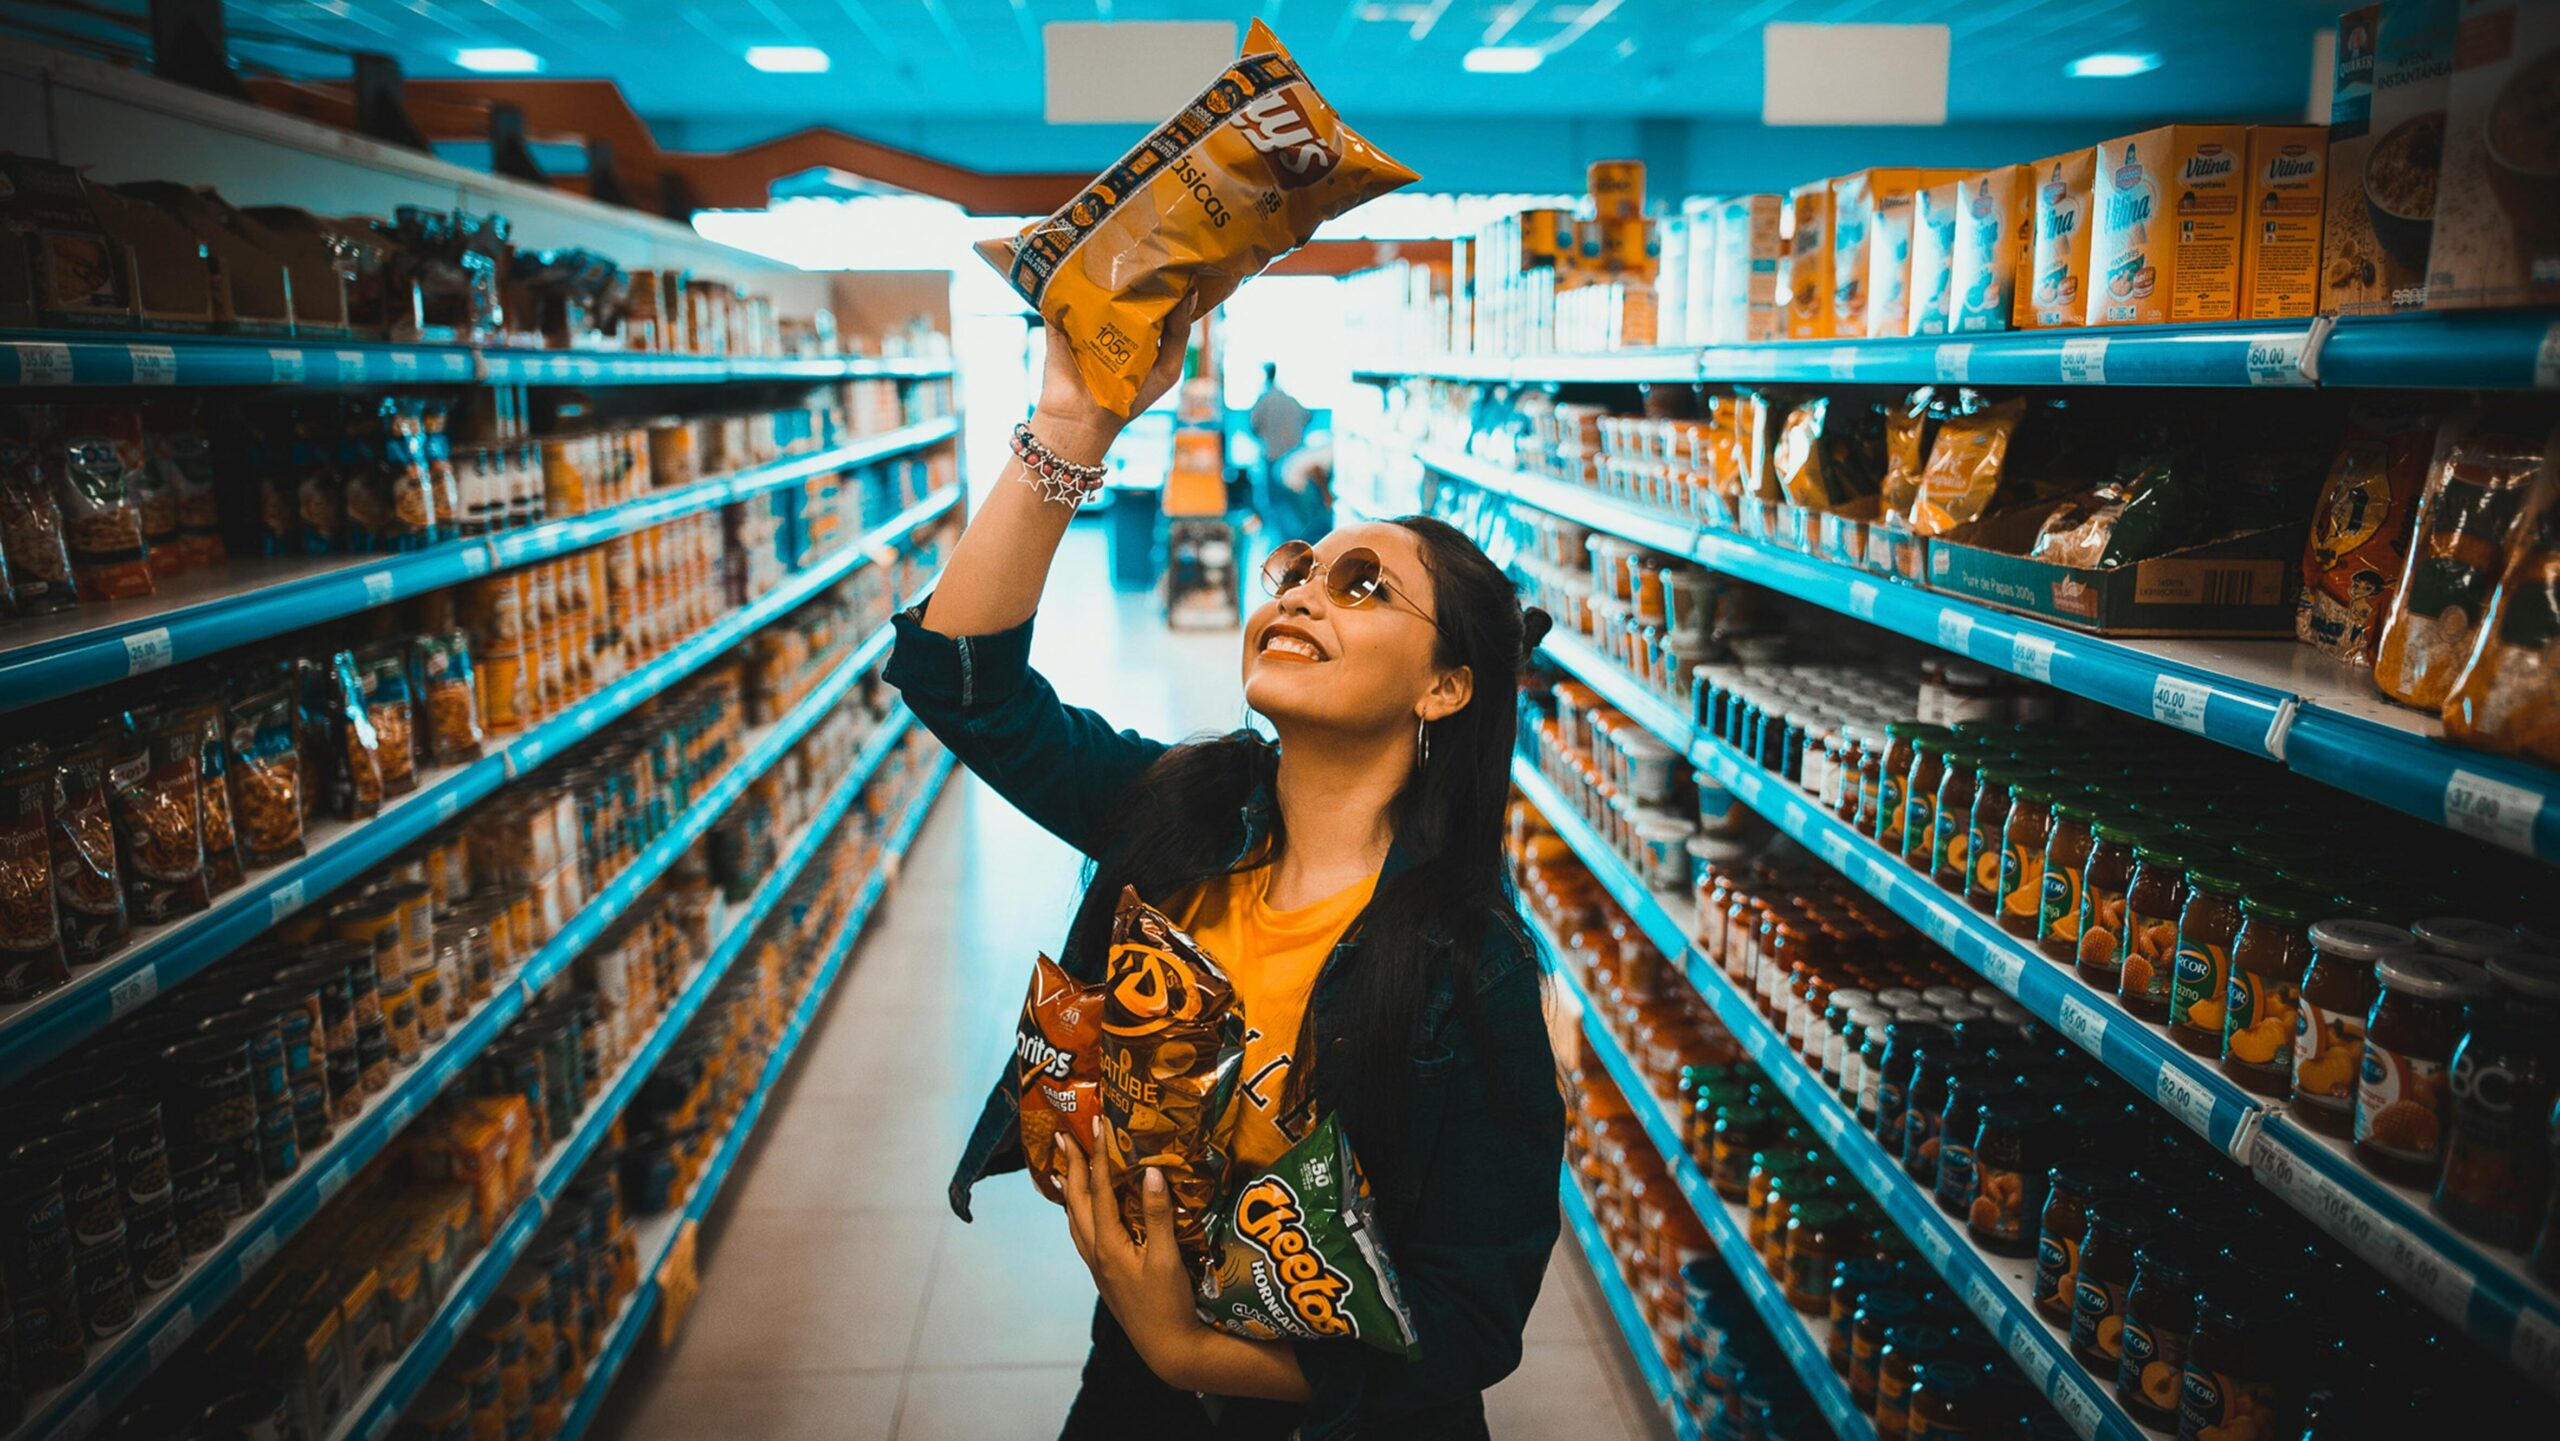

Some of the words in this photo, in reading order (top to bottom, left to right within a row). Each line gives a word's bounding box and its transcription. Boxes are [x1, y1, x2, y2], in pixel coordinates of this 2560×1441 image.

[2186, 157, 2232, 179] Vitina
[2270, 157, 2315, 179] Vitina
[1090, 325, 1135, 367] 105g
